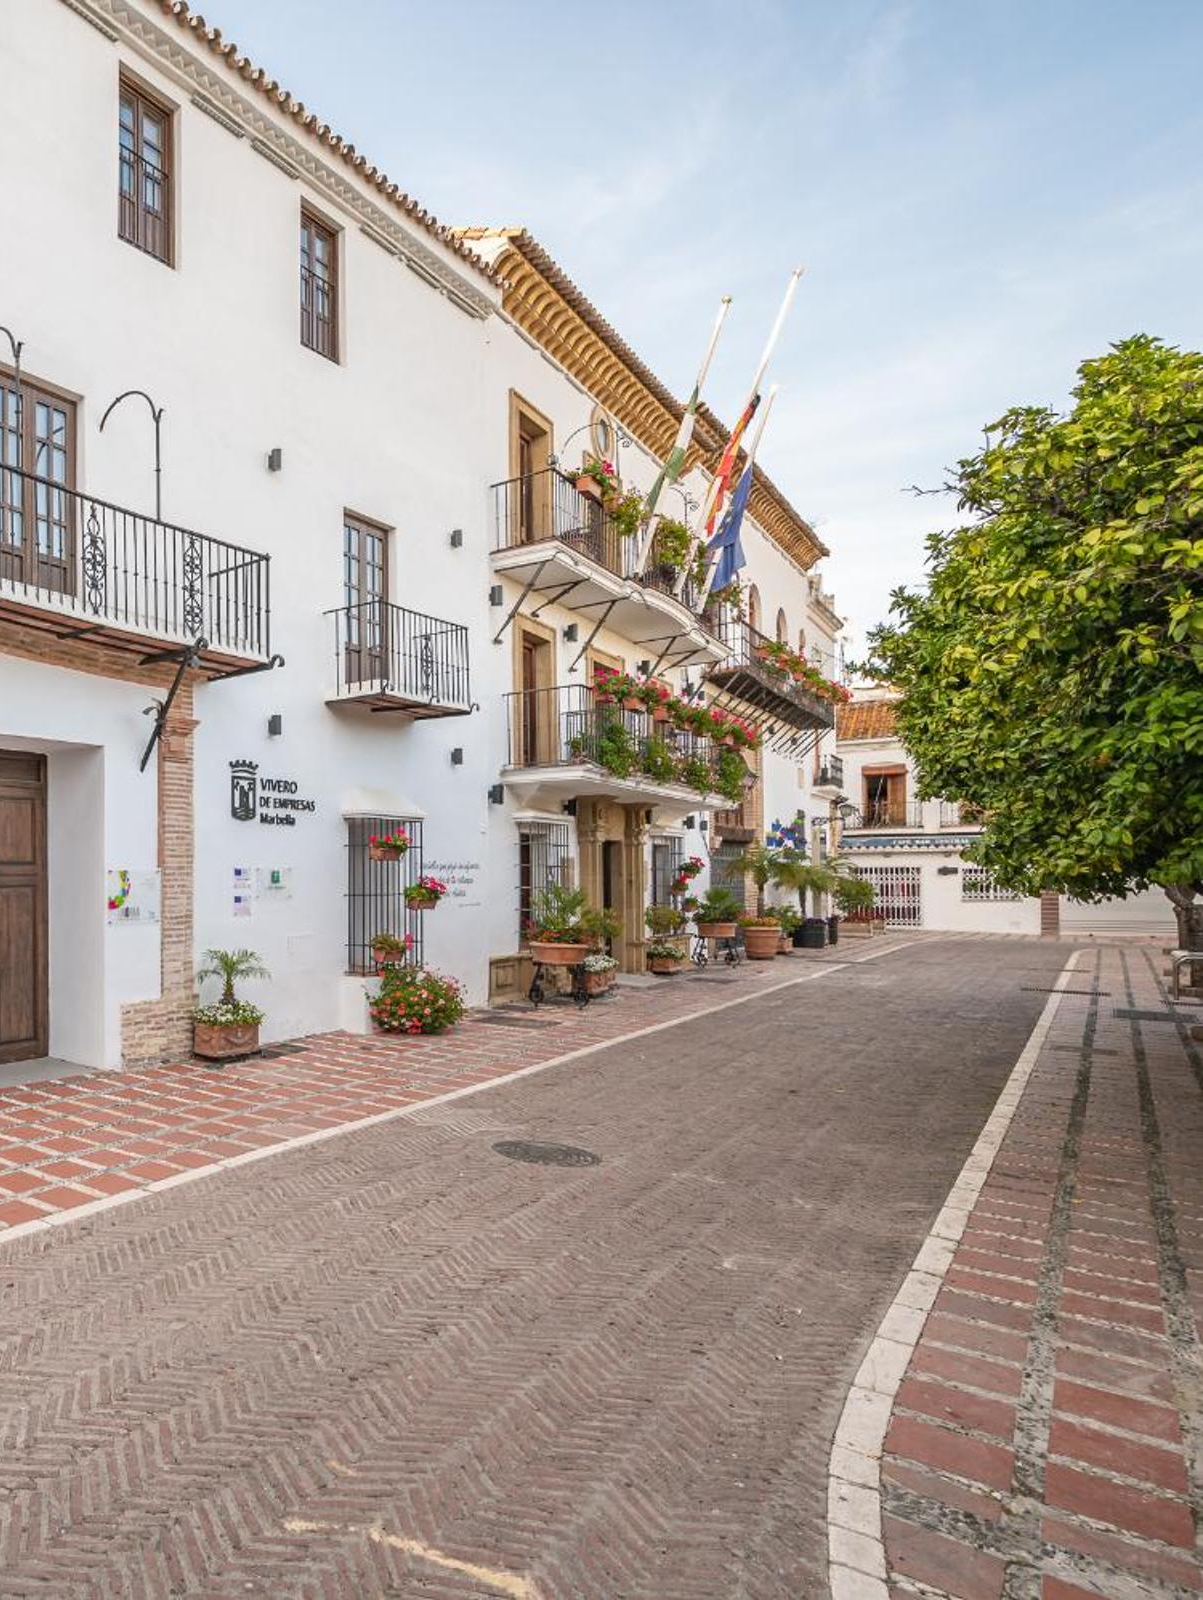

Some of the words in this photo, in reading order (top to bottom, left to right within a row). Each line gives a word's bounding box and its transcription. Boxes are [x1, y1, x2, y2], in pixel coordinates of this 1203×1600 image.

[260, 779, 298, 794] VIVERO
[260, 797, 272, 808] DE
[273, 798, 315, 812] EMPRESAS
[260, 813, 296, 825] Marbella
